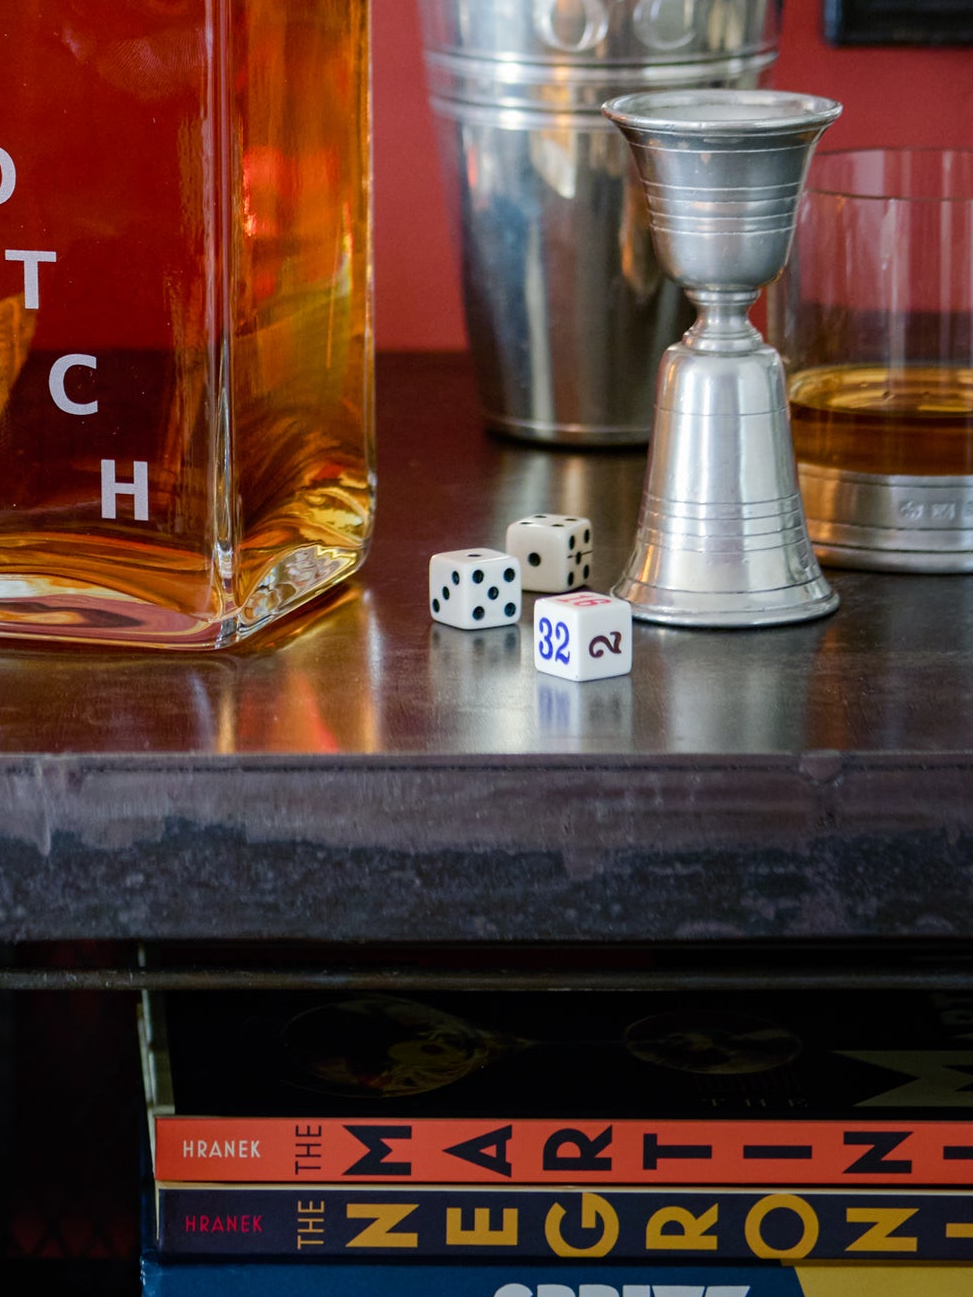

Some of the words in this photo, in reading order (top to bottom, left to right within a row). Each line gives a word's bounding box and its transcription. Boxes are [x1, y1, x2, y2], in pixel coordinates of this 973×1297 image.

[538, 617, 571, 665] 32
[588, 631, 623, 659] 2
[183, 1140, 261, 1159] HRANEK
[295, 1124, 322, 1175] THE
[185, 1214, 263, 1233] HRANEK
[297, 1200, 325, 1250] THE
